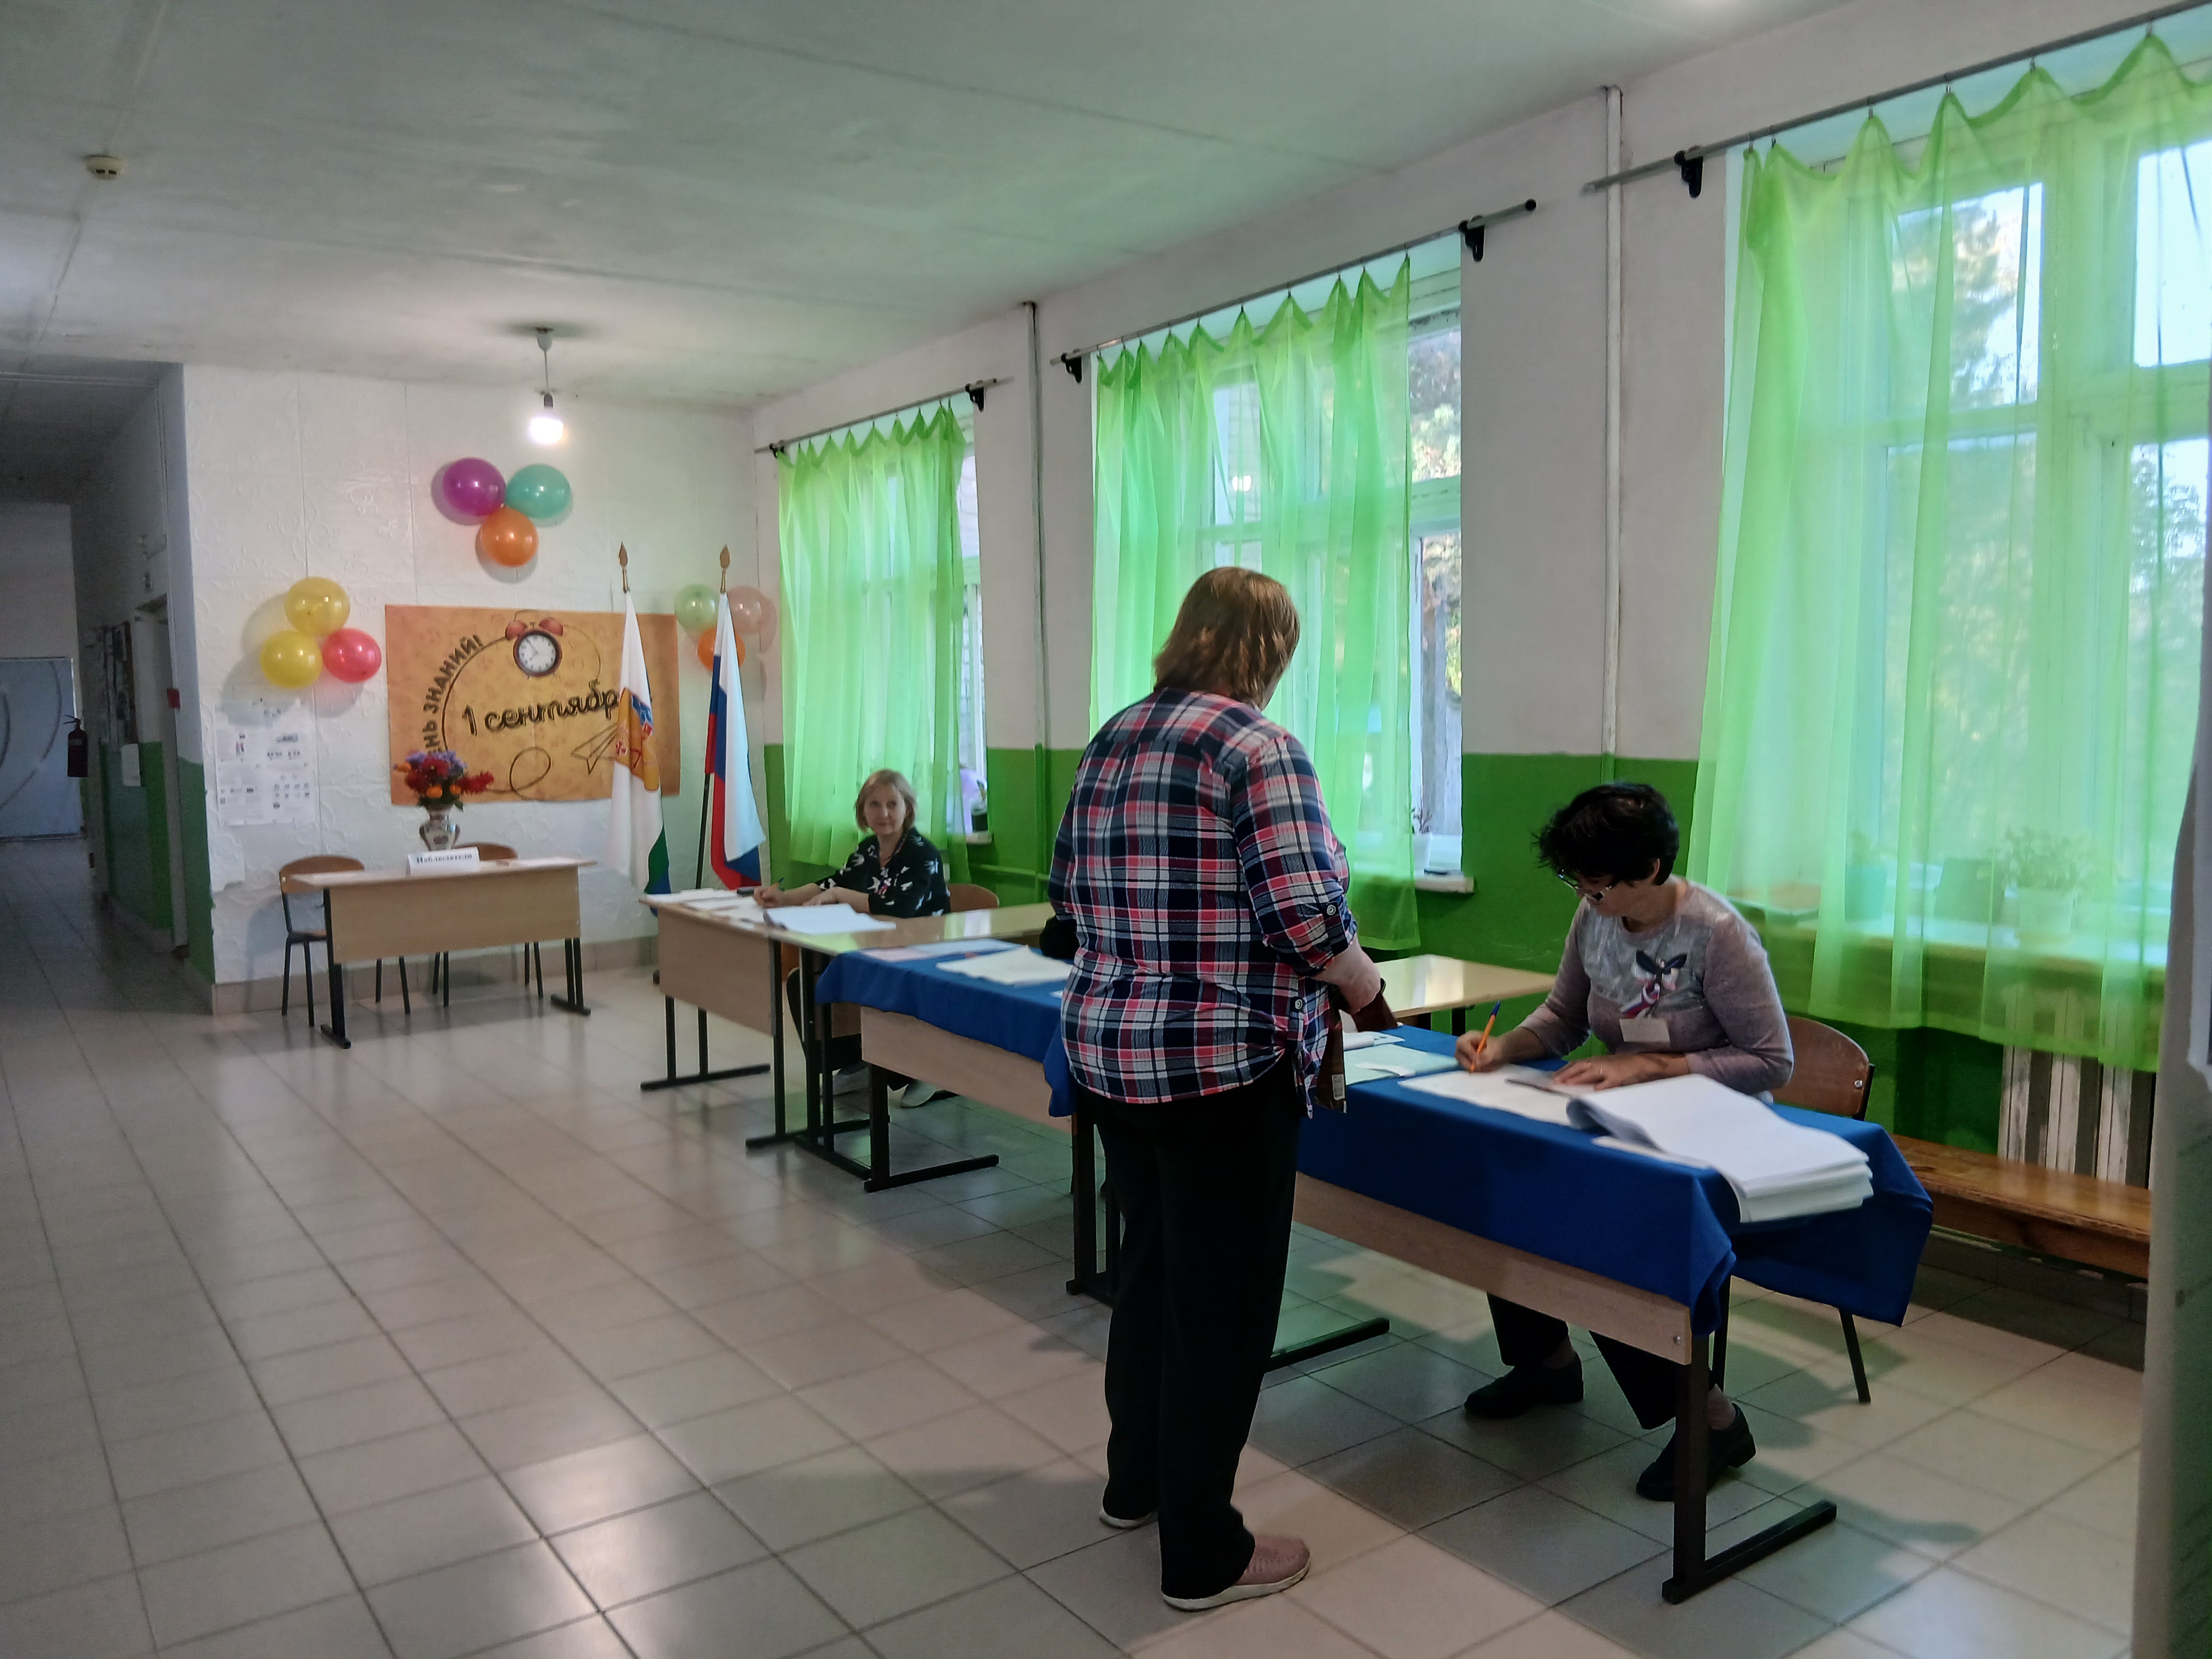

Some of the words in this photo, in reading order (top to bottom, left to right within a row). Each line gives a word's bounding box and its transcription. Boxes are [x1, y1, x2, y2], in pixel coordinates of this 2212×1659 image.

[423, 633, 484, 714] ЗНАНИЙ!
[422, 719, 440, 752] НЬ
[462, 703, 477, 736] 1
[485, 678, 619, 731] сентябр
